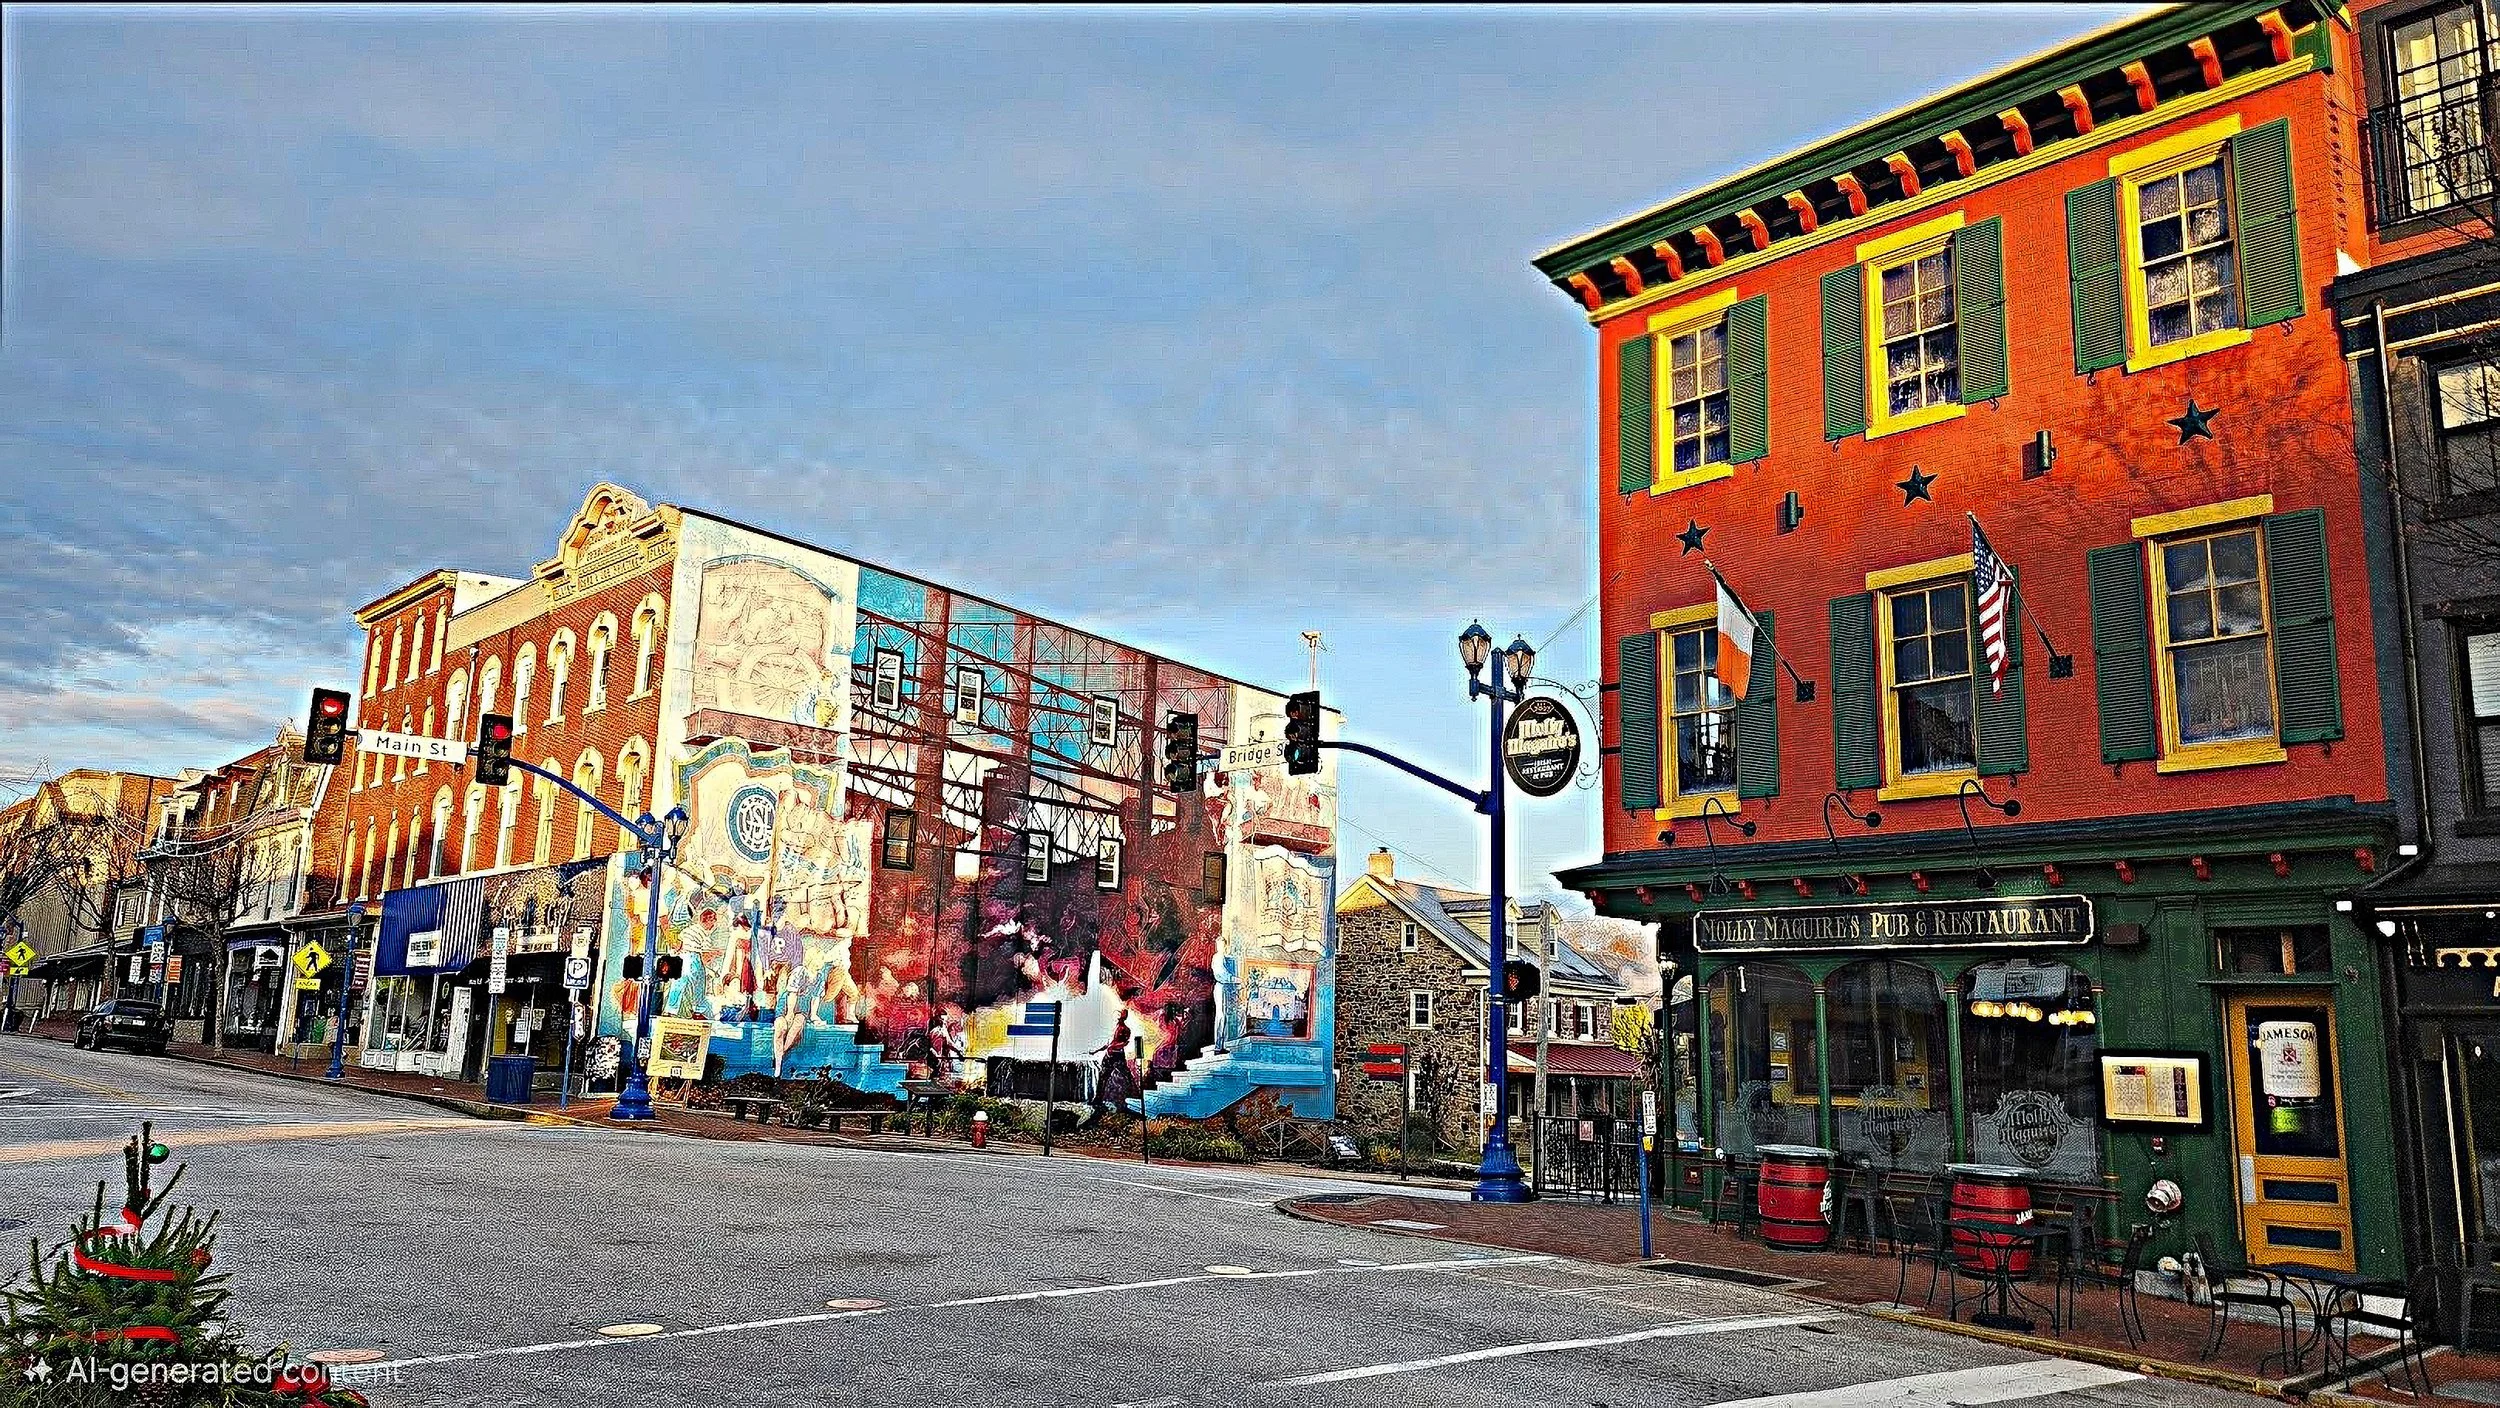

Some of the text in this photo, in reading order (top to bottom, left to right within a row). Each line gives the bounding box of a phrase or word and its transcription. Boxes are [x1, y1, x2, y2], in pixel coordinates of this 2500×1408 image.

[1518, 717, 1565, 739] Molly
[376, 735, 448, 757] Main St
[1229, 742, 1284, 764] Bridge S
[1701, 906, 2081, 942] MOLLY MAGUIRE'S PUB & RESTAURANT
[2262, 1028, 2315, 1041] JAMESON
[2010, 1108, 2052, 1126] Molly
[2015, 1209, 2034, 1225] JAM
